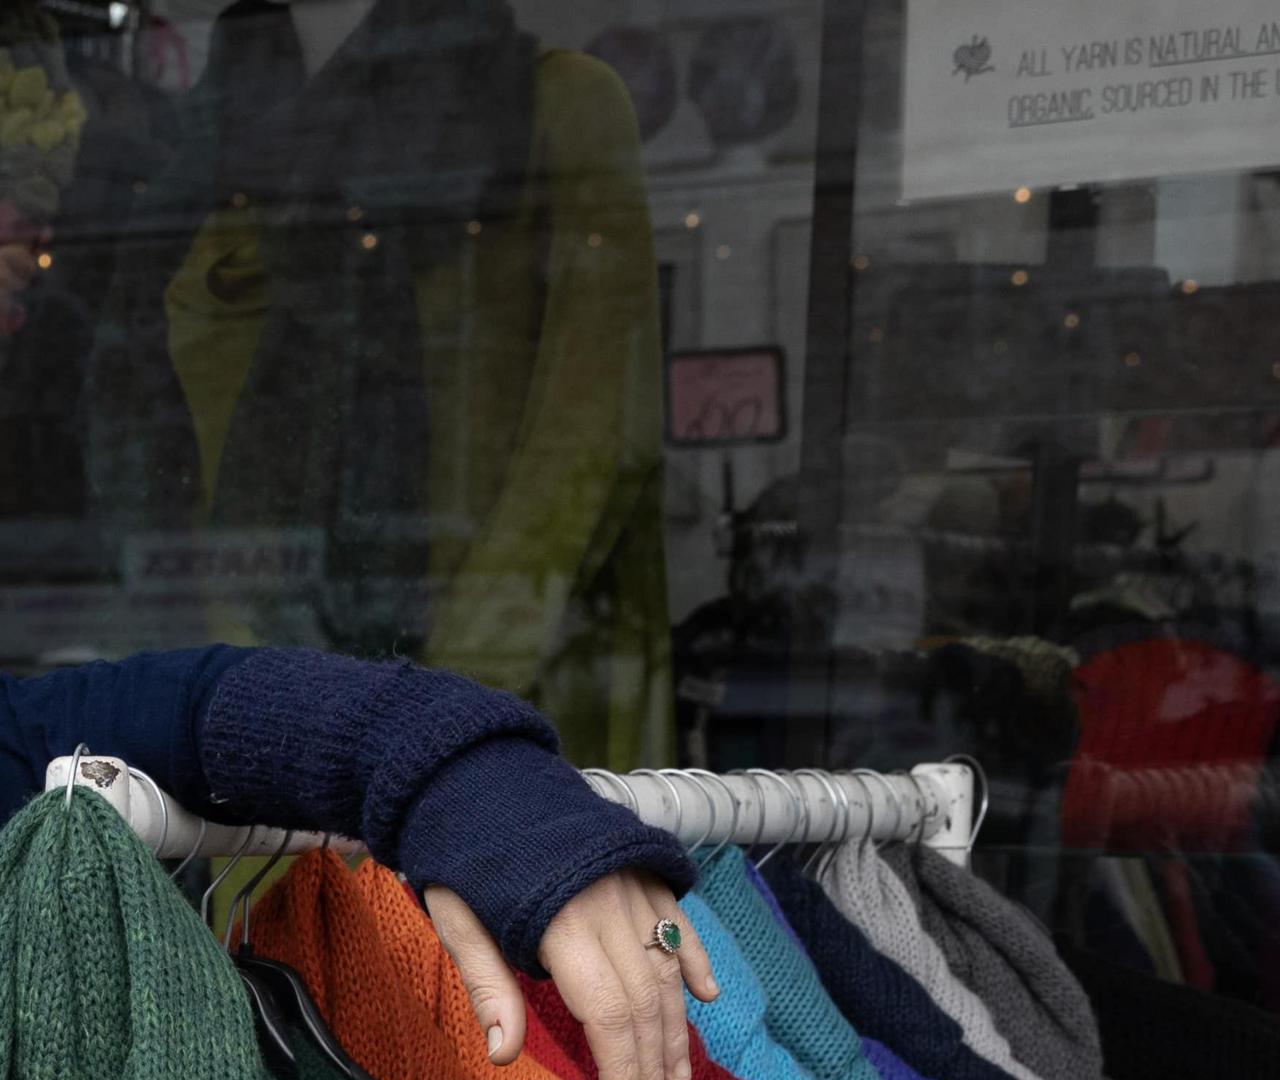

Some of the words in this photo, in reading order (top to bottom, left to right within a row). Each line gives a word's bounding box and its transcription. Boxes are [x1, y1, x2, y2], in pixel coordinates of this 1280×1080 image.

[1017, 50, 1052, 77] ALL
[1062, 40, 1118, 70] YARN
[1124, 36, 1143, 66] IS
[1148, 27, 1247, 62] NATURAL
[1008, 89, 1093, 123] ORGANIC
[1102, 78, 1193, 113] SOURCED
[1200, 74, 1220, 104] IN
[1228, 70, 1268, 99] THE
